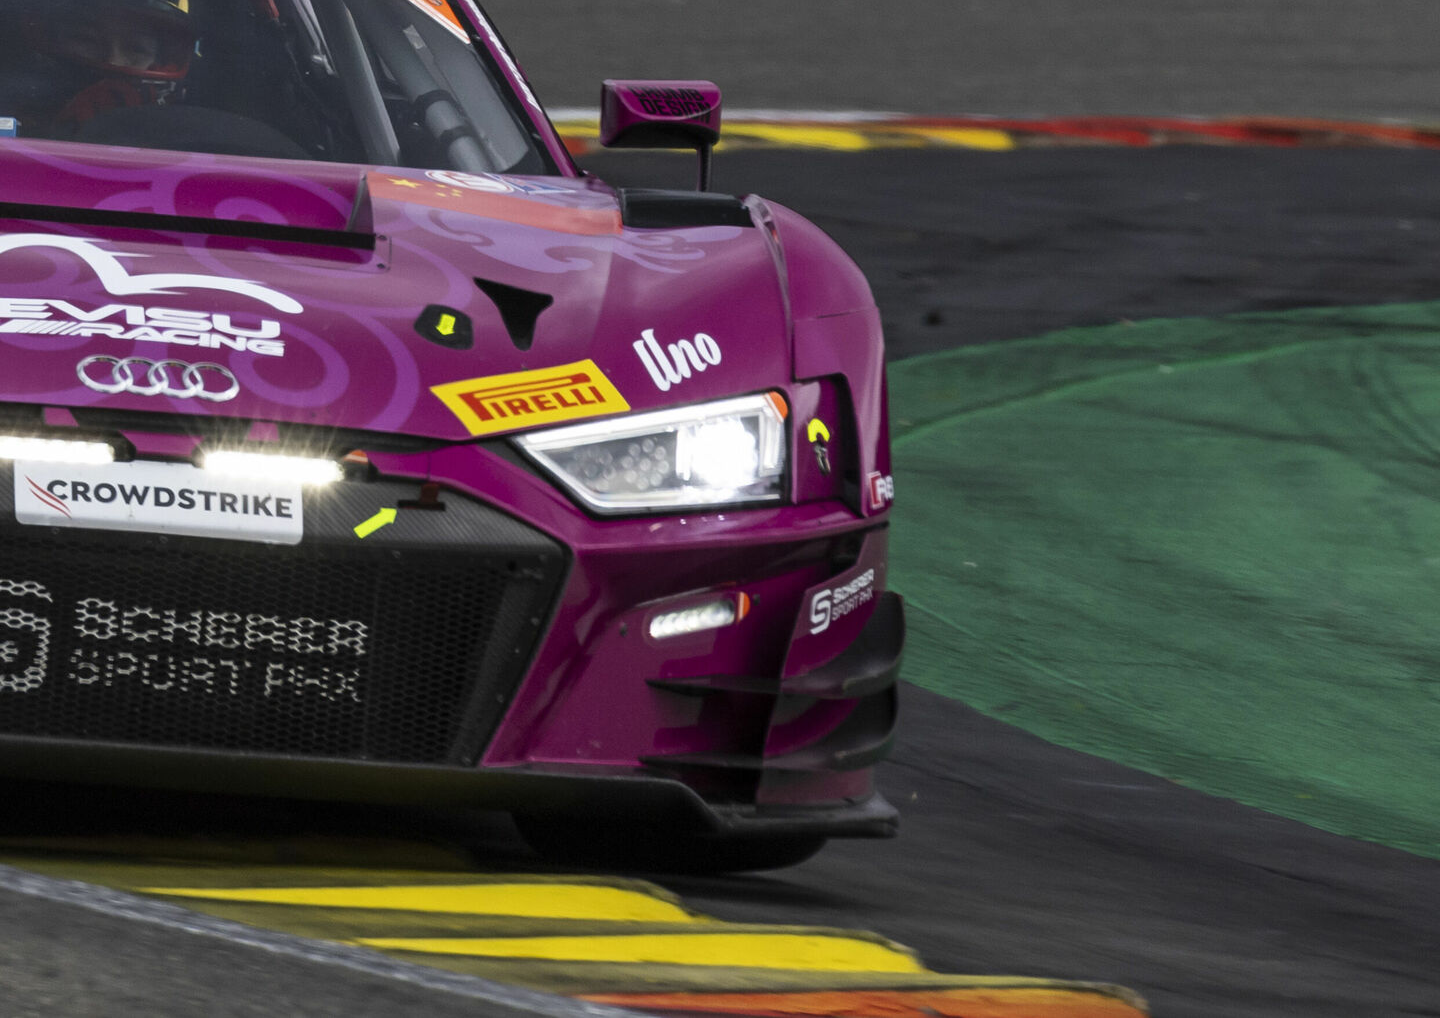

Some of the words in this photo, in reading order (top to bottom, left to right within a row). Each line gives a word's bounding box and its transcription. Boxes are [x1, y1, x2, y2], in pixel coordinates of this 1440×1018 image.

[638, 98, 711, 124] DESIGN
[66, 322, 285, 357] RACING
[632, 329, 722, 391] Uno
[458, 372, 606, 421] PIRELLI
[46, 479, 294, 519] CROWDSTRIKE
[833, 569, 874, 604] SCHERER
[74, 597, 368, 655] SCHERER
[831, 598, 859, 622] SPORT
[69, 648, 252, 695] SPORT
[264, 662, 362, 703] PHX
